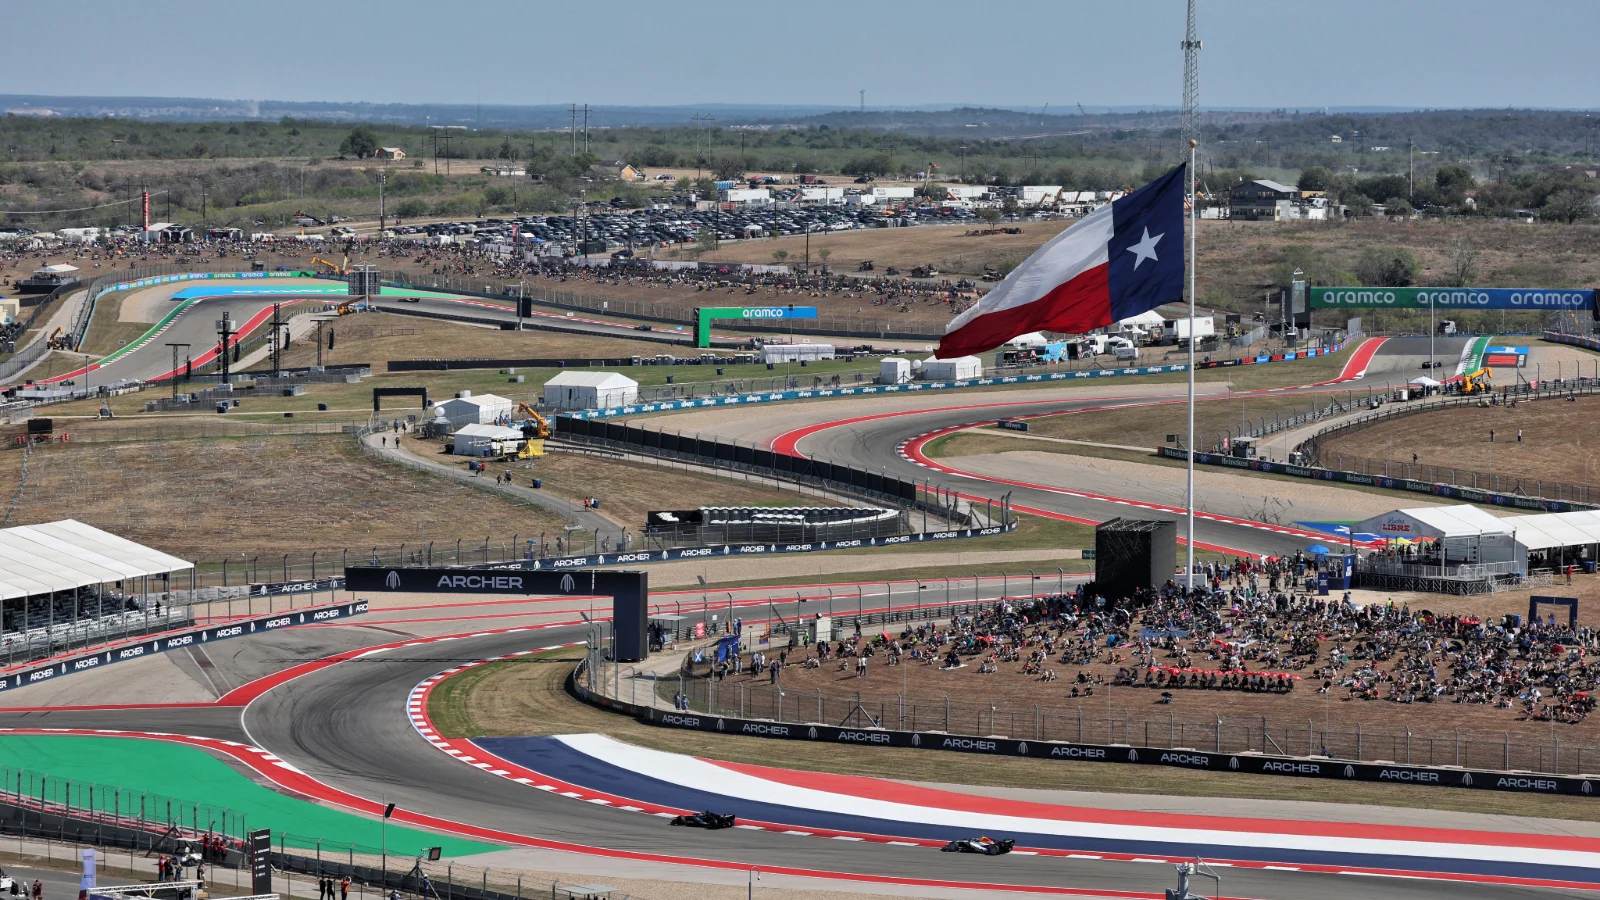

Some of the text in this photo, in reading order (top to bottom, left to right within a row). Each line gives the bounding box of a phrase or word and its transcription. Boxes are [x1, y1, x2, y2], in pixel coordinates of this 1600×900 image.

[1323, 291, 1395, 304] aramco
[1416, 291, 1490, 305] aramco
[1510, 291, 1584, 306] aramco
[742, 308, 783, 317] aramco
[1221, 457, 1249, 467] Heineken
[1285, 466, 1311, 477] Heineken
[1346, 474, 1372, 484] Heineken
[1406, 481, 1431, 492] Heineken
[1382, 524, 1410, 532] LIBRE
[885, 535, 910, 543] ARCHER
[933, 531, 958, 539] ARCHER
[740, 545, 765, 553] ARCHER
[835, 539, 861, 547] ARCHER
[617, 553, 650, 562] ARCHER
[680, 548, 712, 557] ARCHER
[553, 558, 587, 567] ARCHER
[281, 583, 317, 592] ARCHER
[437, 575, 523, 589] ARCHER
[313, 607, 339, 621] ARCHER
[265, 616, 291, 629] ARCHER
[216, 625, 242, 638] ARCHER
[167, 635, 193, 648] ARCHER
[120, 646, 144, 659] ARCHER
[74, 657, 98, 670] ARCHER
[30, 667, 54, 681] ARCHER
[662, 714, 700, 727] ARCHER
[742, 723, 789, 736] ARCHER
[838, 731, 890, 743] ARCHER
[943, 738, 996, 751] ARCHER
[1051, 746, 1105, 759] ARCHER
[1160, 753, 1209, 766] ARCHER
[1262, 761, 1320, 774] ARCHER
[1379, 769, 1439, 782] ARCHER
[1497, 777, 1557, 791] ARCHER
